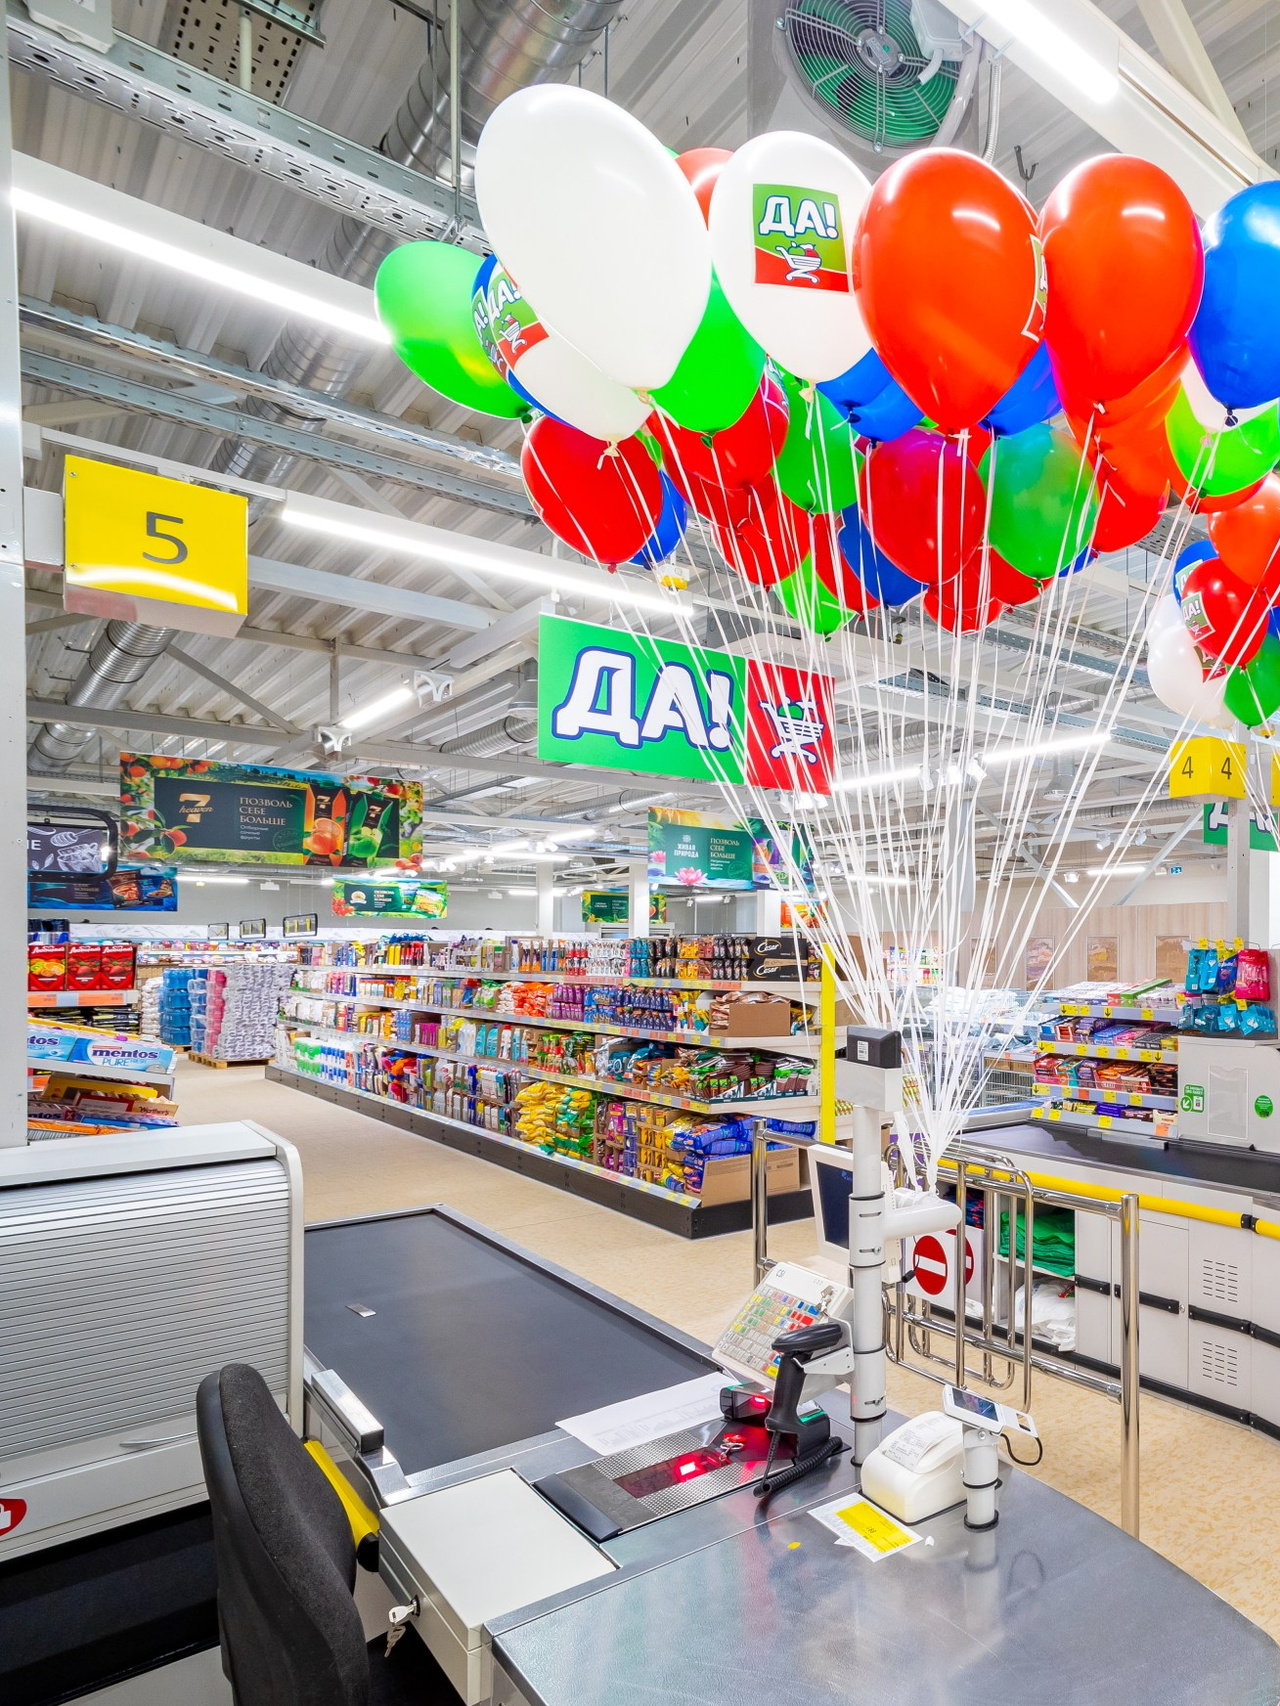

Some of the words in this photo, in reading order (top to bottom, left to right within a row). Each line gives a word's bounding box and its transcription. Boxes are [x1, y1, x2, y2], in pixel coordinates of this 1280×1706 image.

[758, 194, 839, 240] ДА!
[142, 511, 189, 565] 5
[1181, 600, 1201, 621] ДА!
[552, 646, 734, 753] ДА!
[1182, 755, 1194, 779] 4
[1221, 757, 1233, 780] 4
[179, 793, 211, 823] 7
[240, 797, 293, 808] ПОЗВОЛЬ
[179, 805, 214, 813] heaven
[239, 807, 267, 815] СЕБЕ
[240, 816, 286, 826] БОЛЬШЕ
[677, 843, 696, 851] ЖИВАЯ
[710, 837, 740, 847] ПОЗВОЛЬ
[673, 850, 699, 858] ПРИРОДА
[757, 942, 780, 953] Cesar
[27, 1035, 59, 1046] tos
[91, 1049, 158, 1060] mentos
[102, 1057, 130, 1067] PURE
